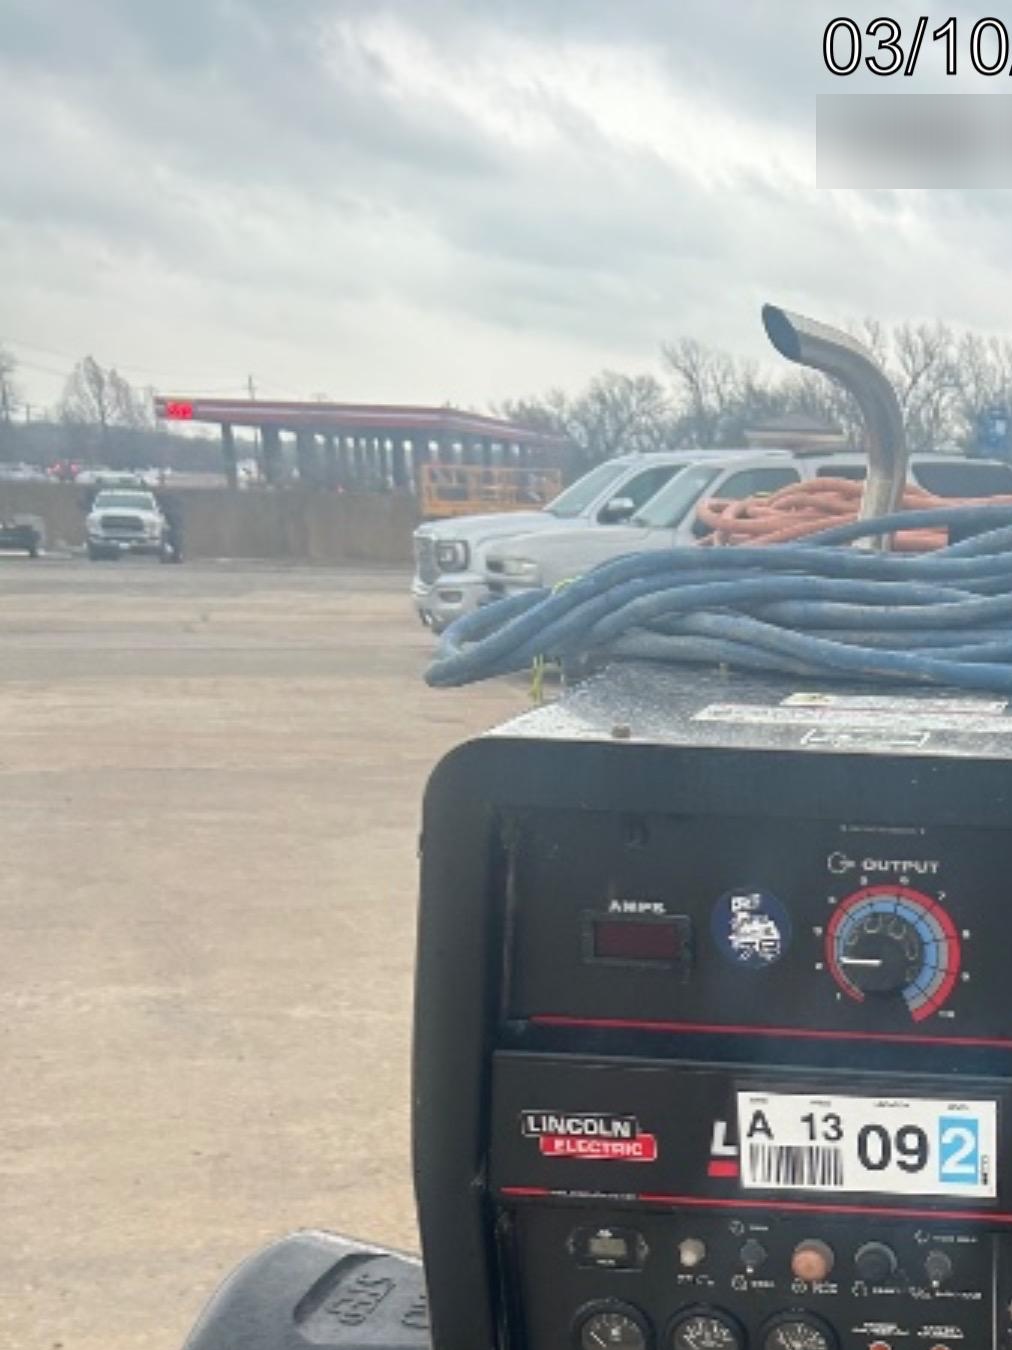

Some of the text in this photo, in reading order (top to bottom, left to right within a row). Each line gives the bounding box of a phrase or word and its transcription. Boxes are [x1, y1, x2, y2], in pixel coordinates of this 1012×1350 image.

[862, 857, 939, 874] OUTPUT
[608, 899, 667, 915] AMPS
[526, 1115, 631, 1138] LINCOLN
[746, 1109, 844, 1141] A 13
[554, 1139, 644, 1157] ELECTRIC
[857, 1123, 978, 1175] 09 2
